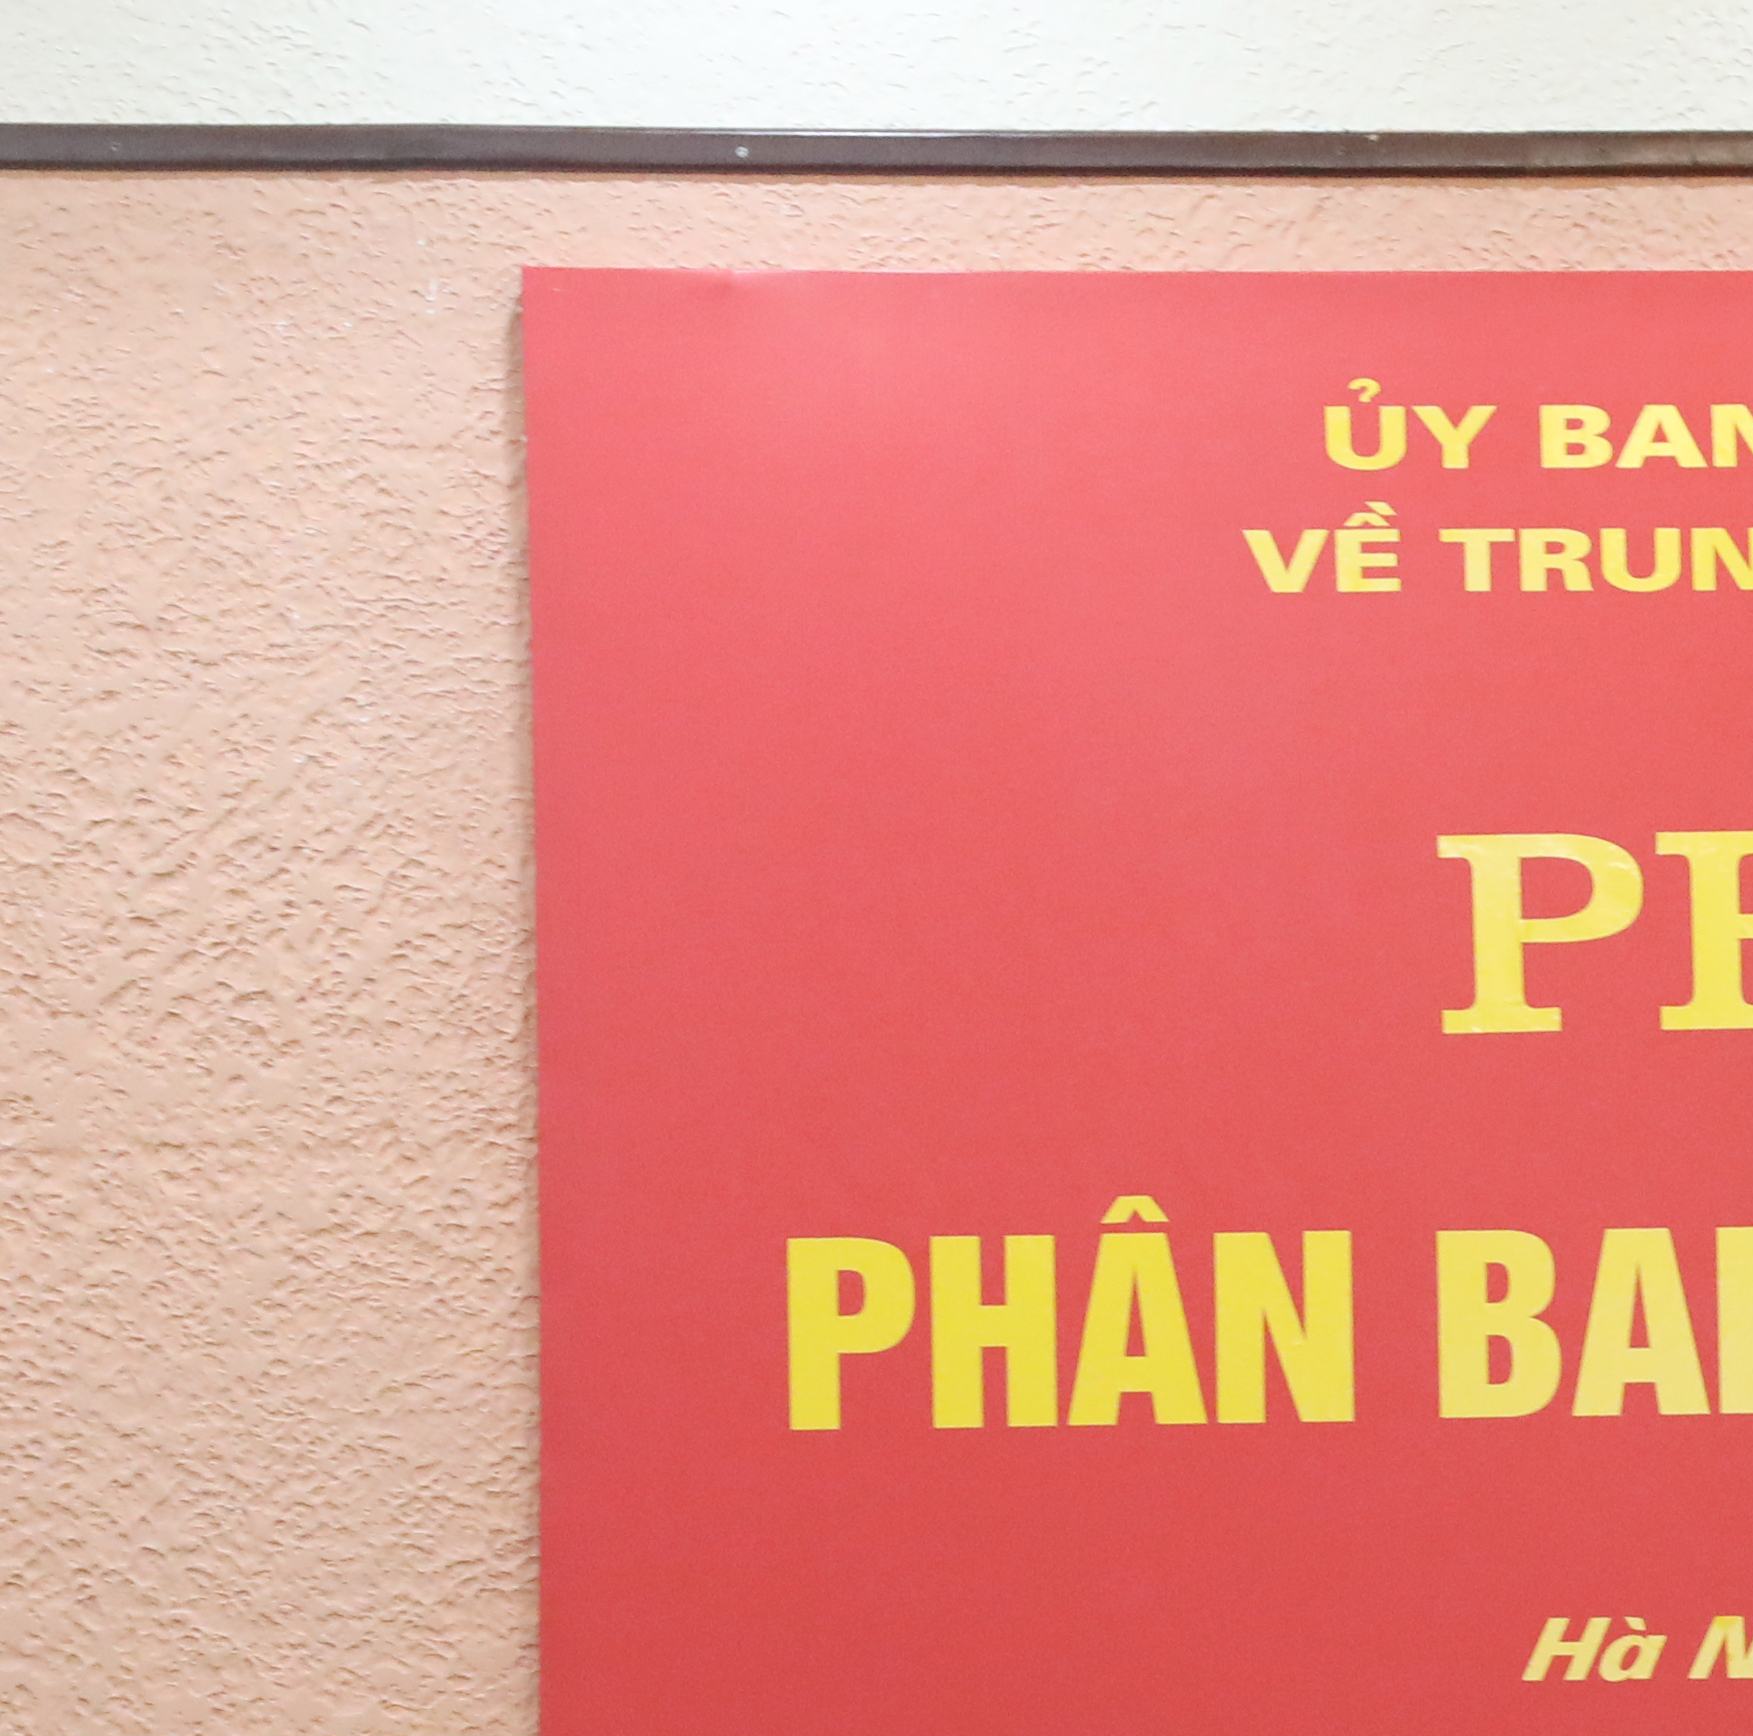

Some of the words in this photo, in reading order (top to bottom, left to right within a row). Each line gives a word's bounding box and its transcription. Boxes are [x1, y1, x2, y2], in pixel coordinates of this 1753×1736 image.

[1323, 377, 1496, 472] ỦY
[1243, 501, 1402, 594] VỀ
[786, 1194, 1356, 1431] PHÂN
[1524, 1616, 1668, 1682] Hà
